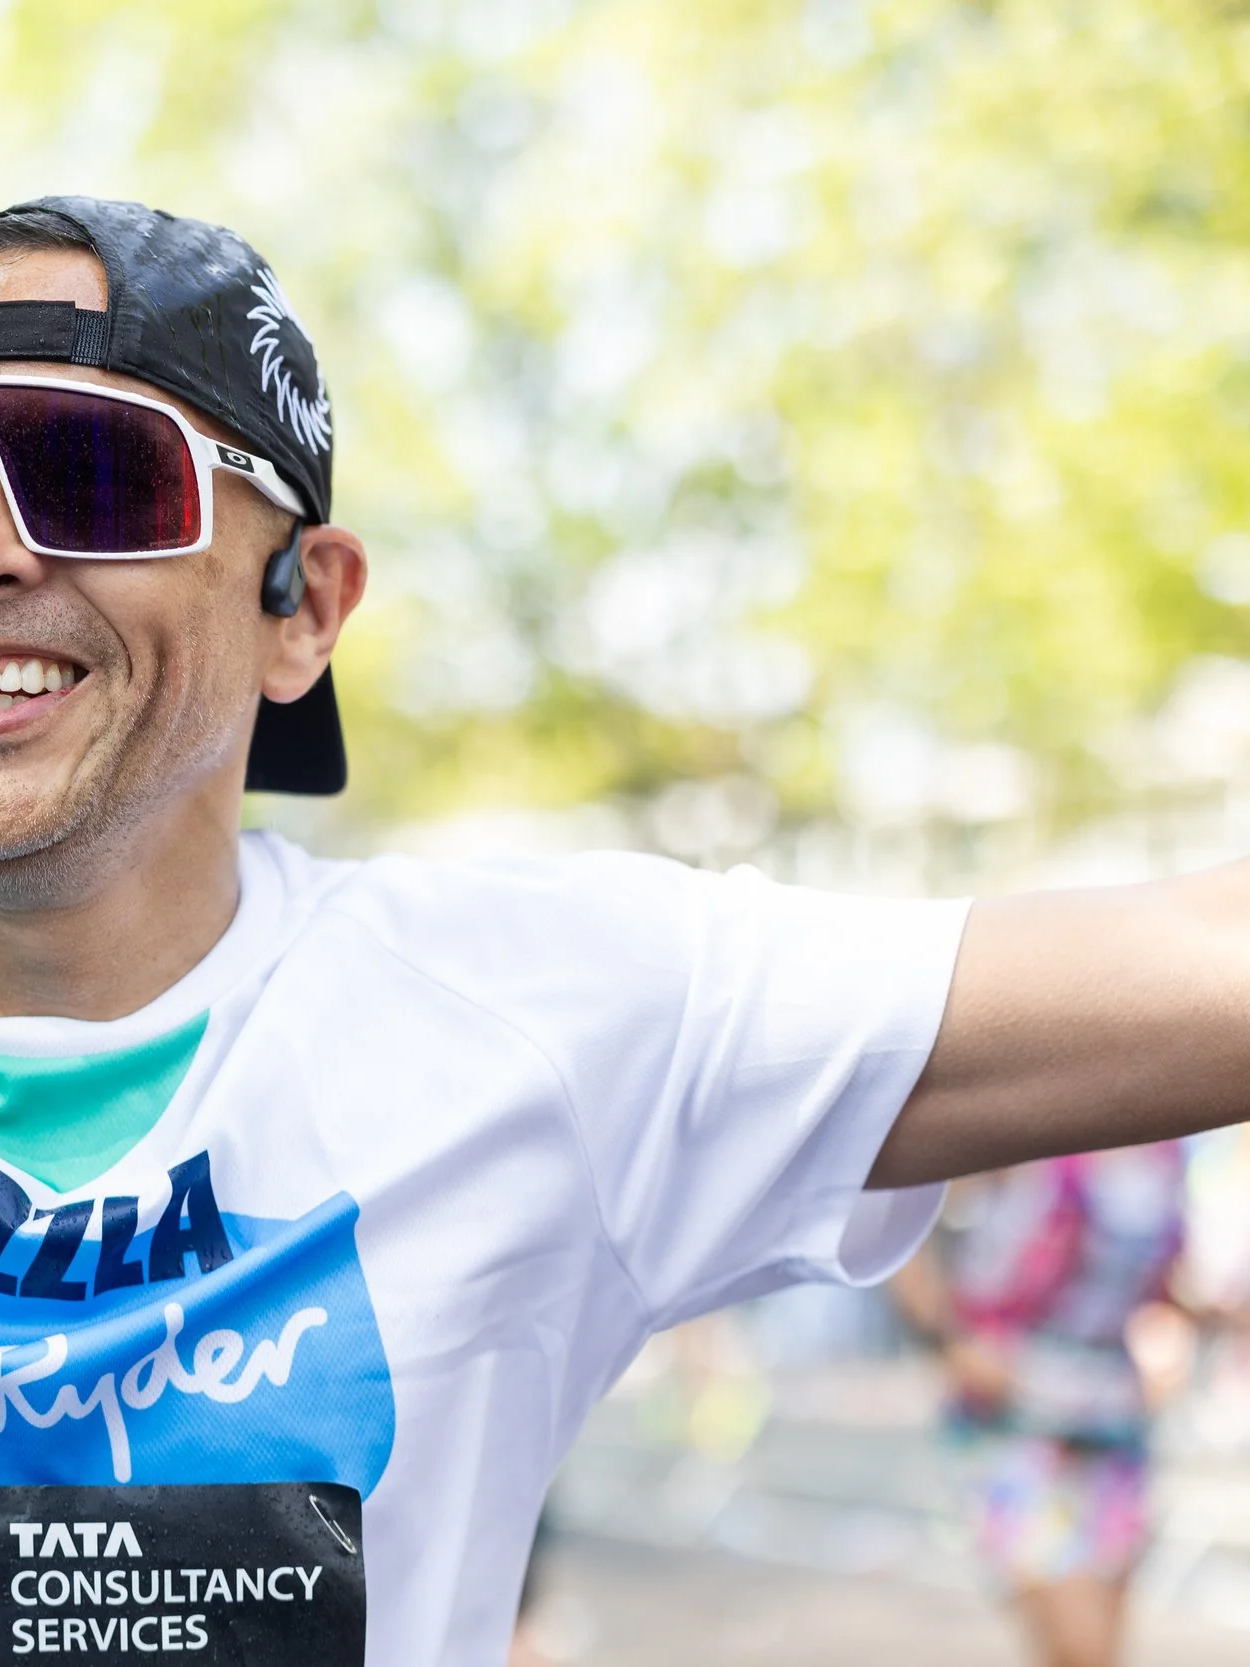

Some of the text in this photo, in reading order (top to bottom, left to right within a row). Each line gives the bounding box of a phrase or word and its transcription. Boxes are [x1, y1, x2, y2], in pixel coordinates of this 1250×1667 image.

[9, 1521, 143, 1558] TATA
[9, 1565, 323, 1606] CONSULTANCY
[11, 1614, 209, 1655] SERVICES
